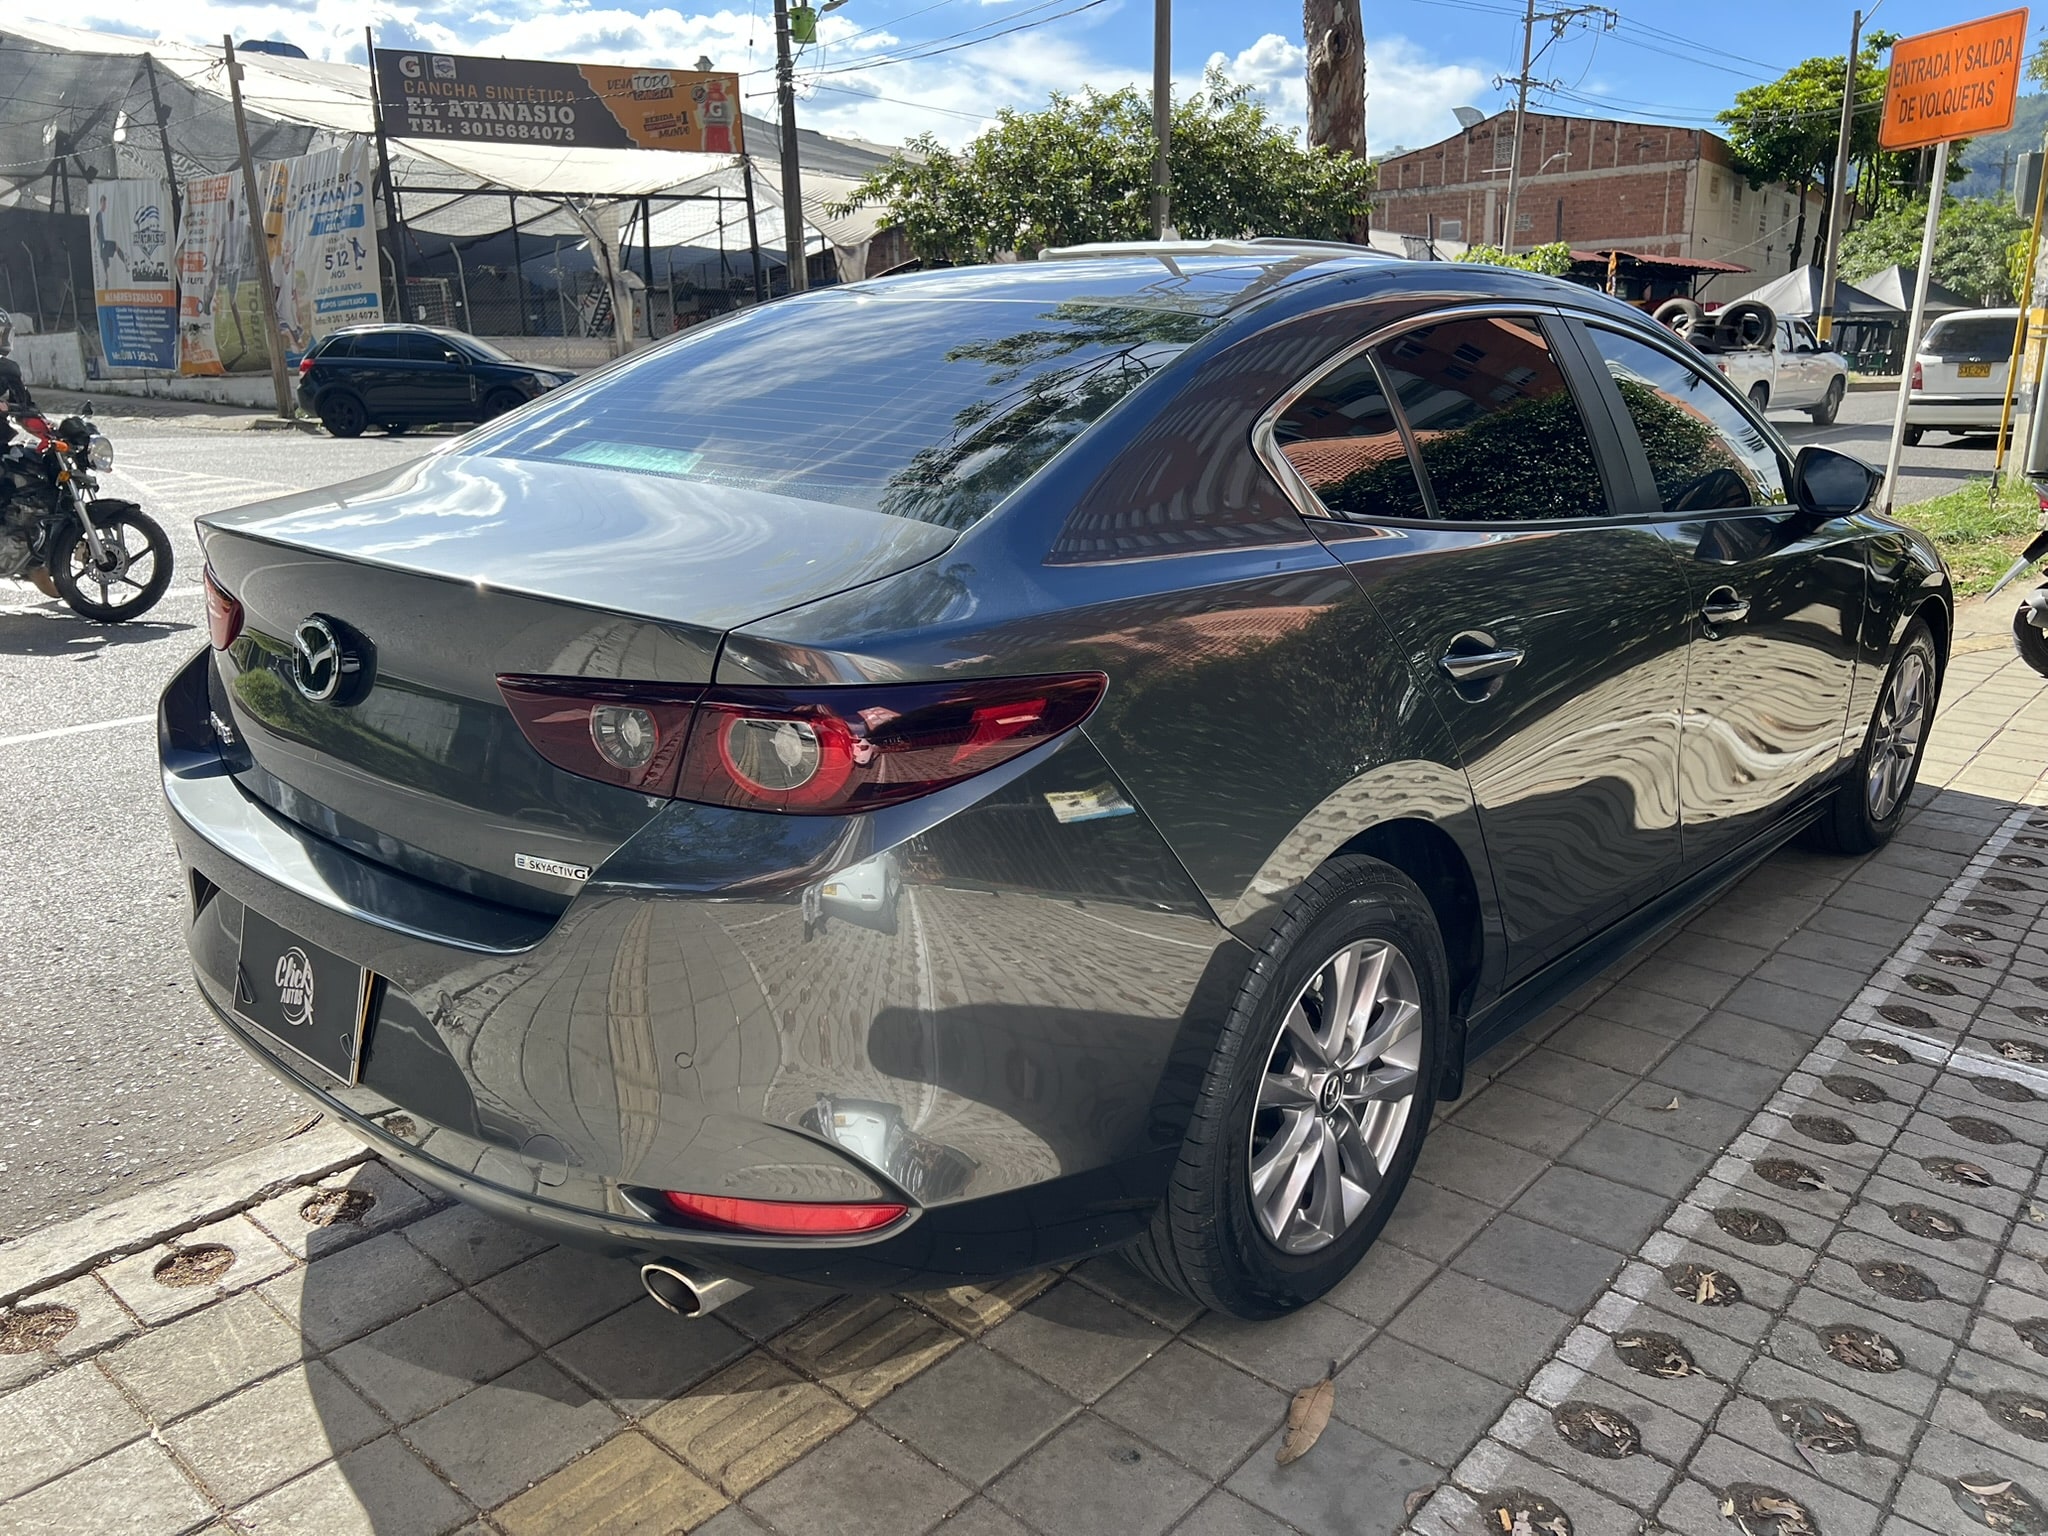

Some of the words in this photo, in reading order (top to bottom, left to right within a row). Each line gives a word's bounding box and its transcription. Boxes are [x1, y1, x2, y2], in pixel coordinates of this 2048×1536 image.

[1893, 54, 1950, 88] ENTRADA
[1954, 47, 1964, 74] Y
[1965, 37, 2012, 72] SALIDA
[404, 80, 479, 98] CANCHA
[485, 85, 576, 104] SINTÉTICA
[634, 74, 670, 89] TODO
[406, 97, 439, 116] EL
[448, 100, 576, 125] ATANASIO
[1899, 96, 1917, 123] DE
[1919, 79, 1995, 120] VOLQUETAS
[407, 118, 453, 133] TEL:
[460, 121, 576, 141] 3015684073
[275, 956, 313, 997] Click
[280, 987, 304, 1005] AUTOS
